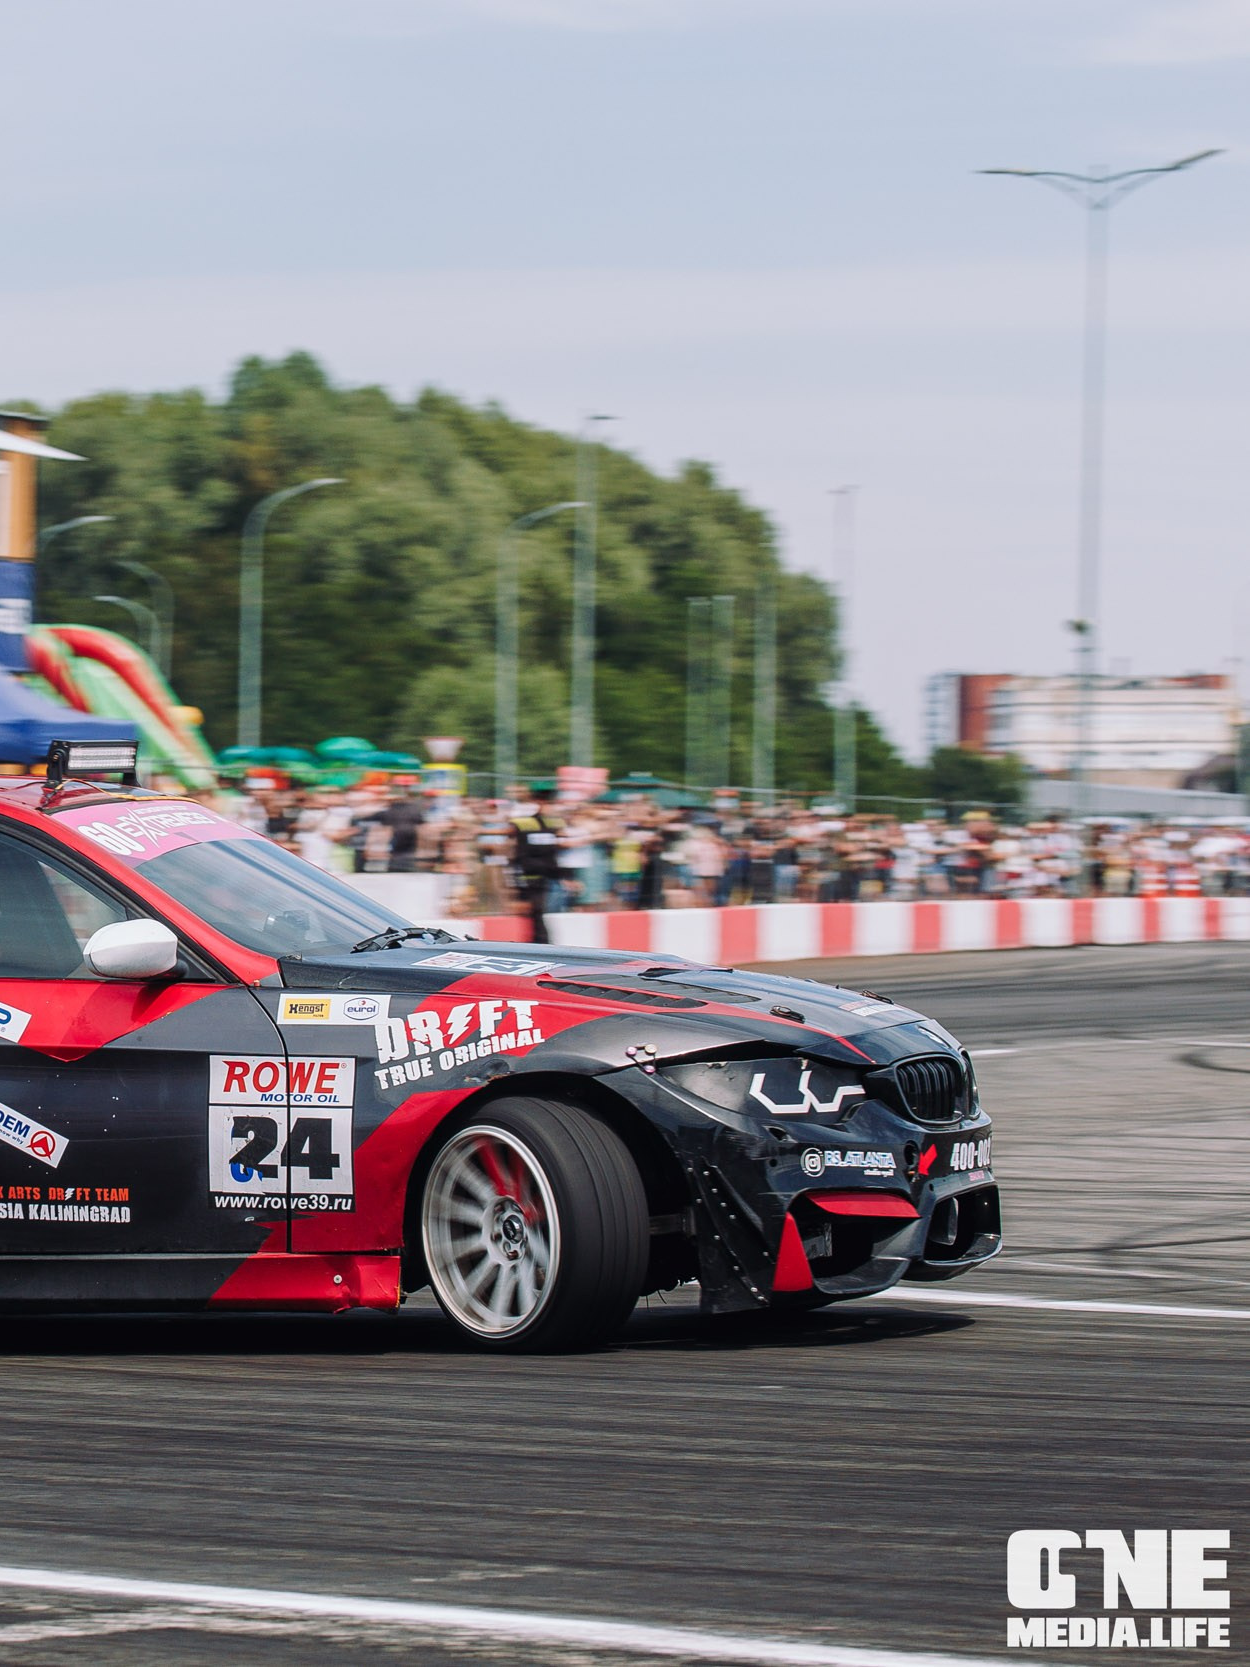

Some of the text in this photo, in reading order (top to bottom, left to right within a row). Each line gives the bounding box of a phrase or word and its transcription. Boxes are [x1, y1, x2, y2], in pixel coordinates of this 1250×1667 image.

[77, 822, 146, 856] 60
[289, 1003, 325, 1015] Hengst
[374, 1028, 546, 1090] TRUE ORIGINAL
[222, 1060, 341, 1094] ROWE
[260, 1093, 340, 1103] MOTOR OIL
[12, 1134, 24, 1145] why
[229, 1116, 340, 1180] 24
[8, 1186, 41, 1200] ARTS
[95, 1188, 129, 1201] TEAM
[214, 1194, 352, 1211] www.rowe39.ru
[29, 1204, 131, 1223] KALININGRAD
